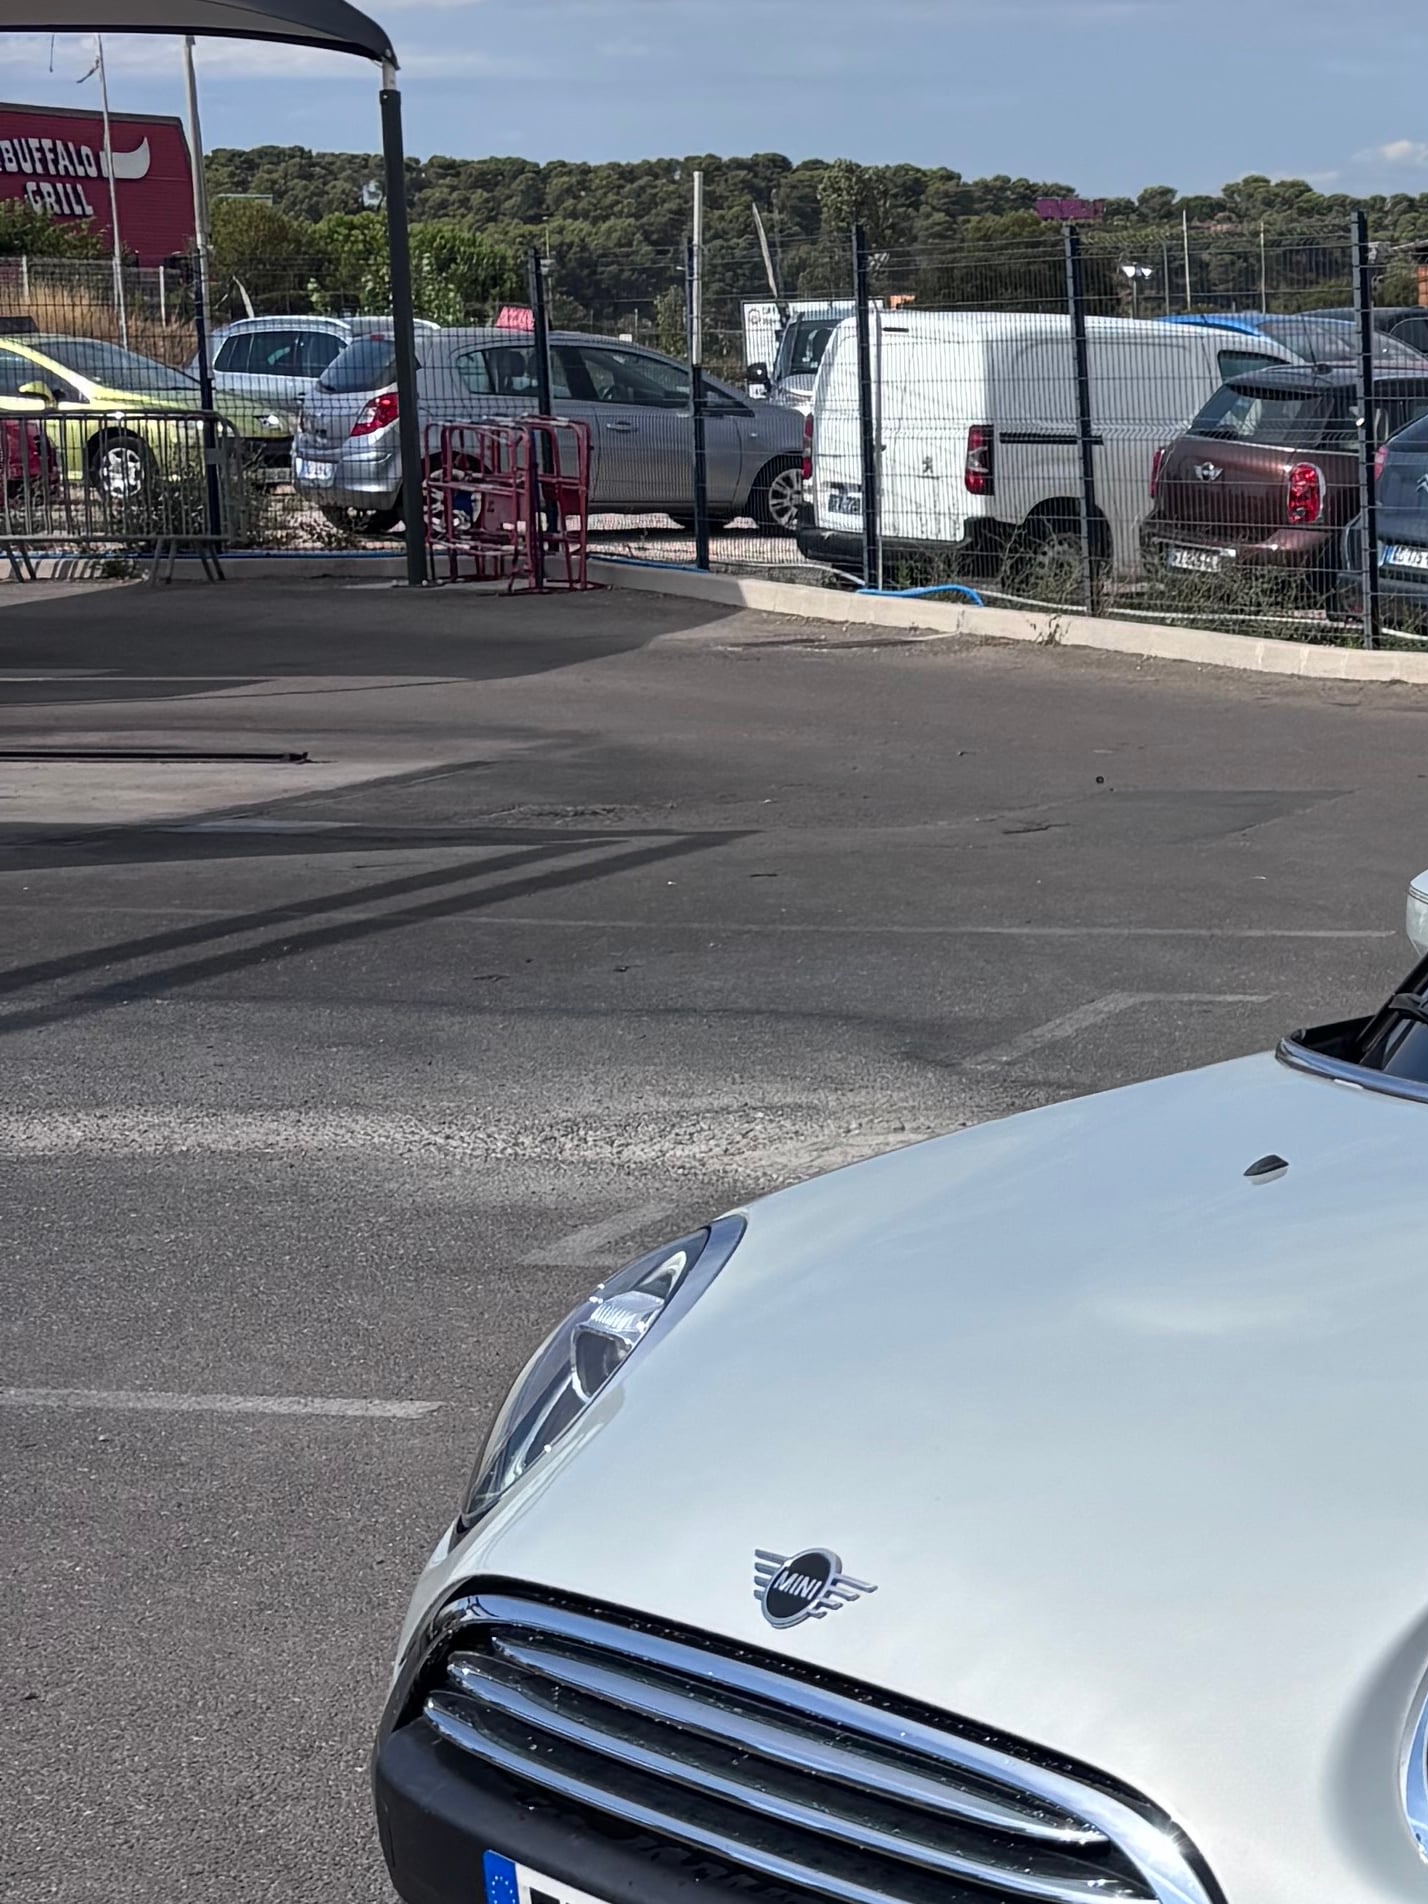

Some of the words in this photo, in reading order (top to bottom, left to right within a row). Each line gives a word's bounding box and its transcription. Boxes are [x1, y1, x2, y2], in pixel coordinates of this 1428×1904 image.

[0, 137, 98, 178] BUFFALO
[25, 181, 94, 216] GRILL
[773, 1570, 823, 1601] MINI
